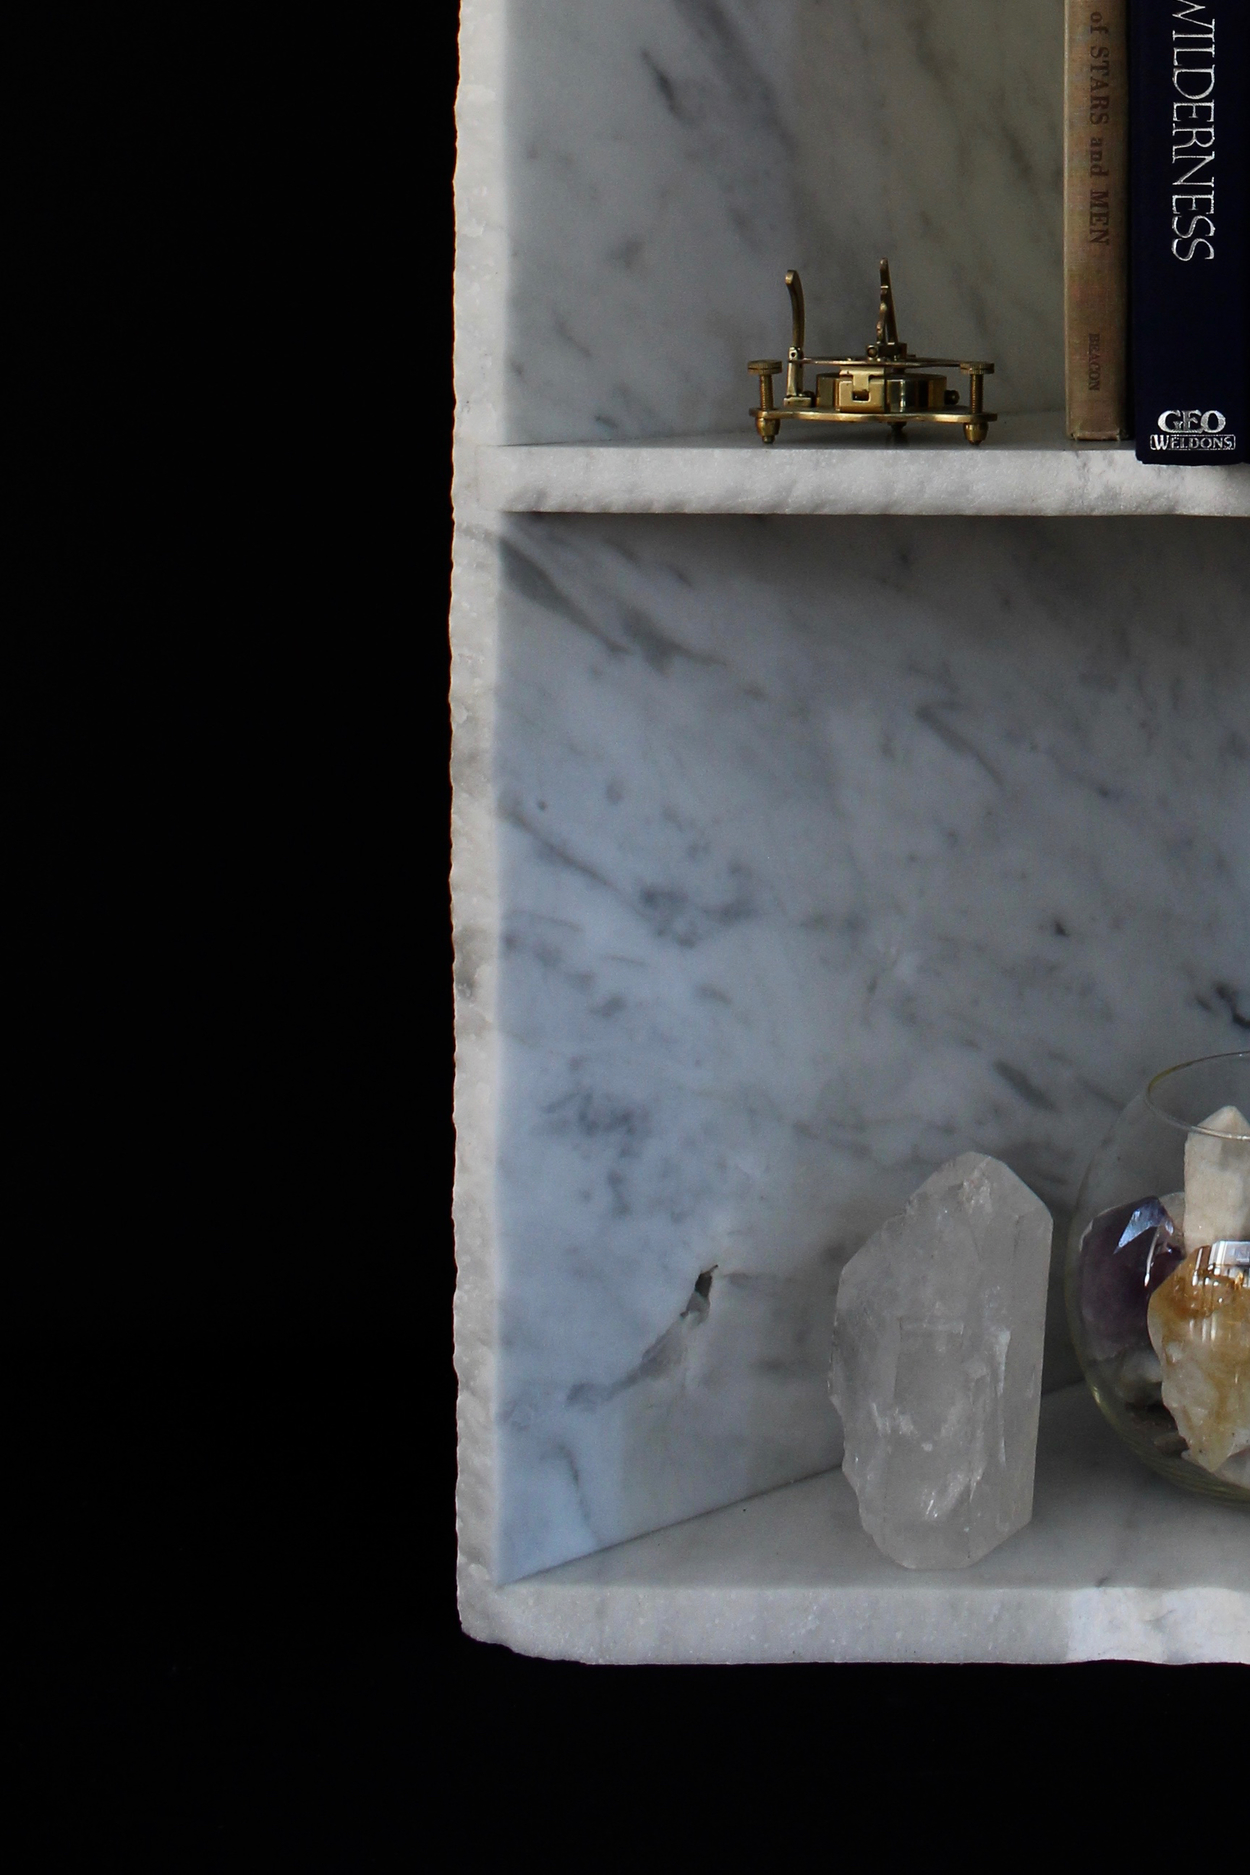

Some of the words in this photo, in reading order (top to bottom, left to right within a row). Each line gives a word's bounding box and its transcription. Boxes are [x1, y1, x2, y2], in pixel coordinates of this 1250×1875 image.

[1089, 10, 1109, 34] of
[1089, 45, 1109, 126] STARS
[1089, 136, 1109, 178] and
[1089, 189, 1109, 245] MEN
[1087, 333, 1101, 392] BEACON
[1151, 433, 1236, 450] WELDONS
[1157, 408, 1227, 434] GEO
